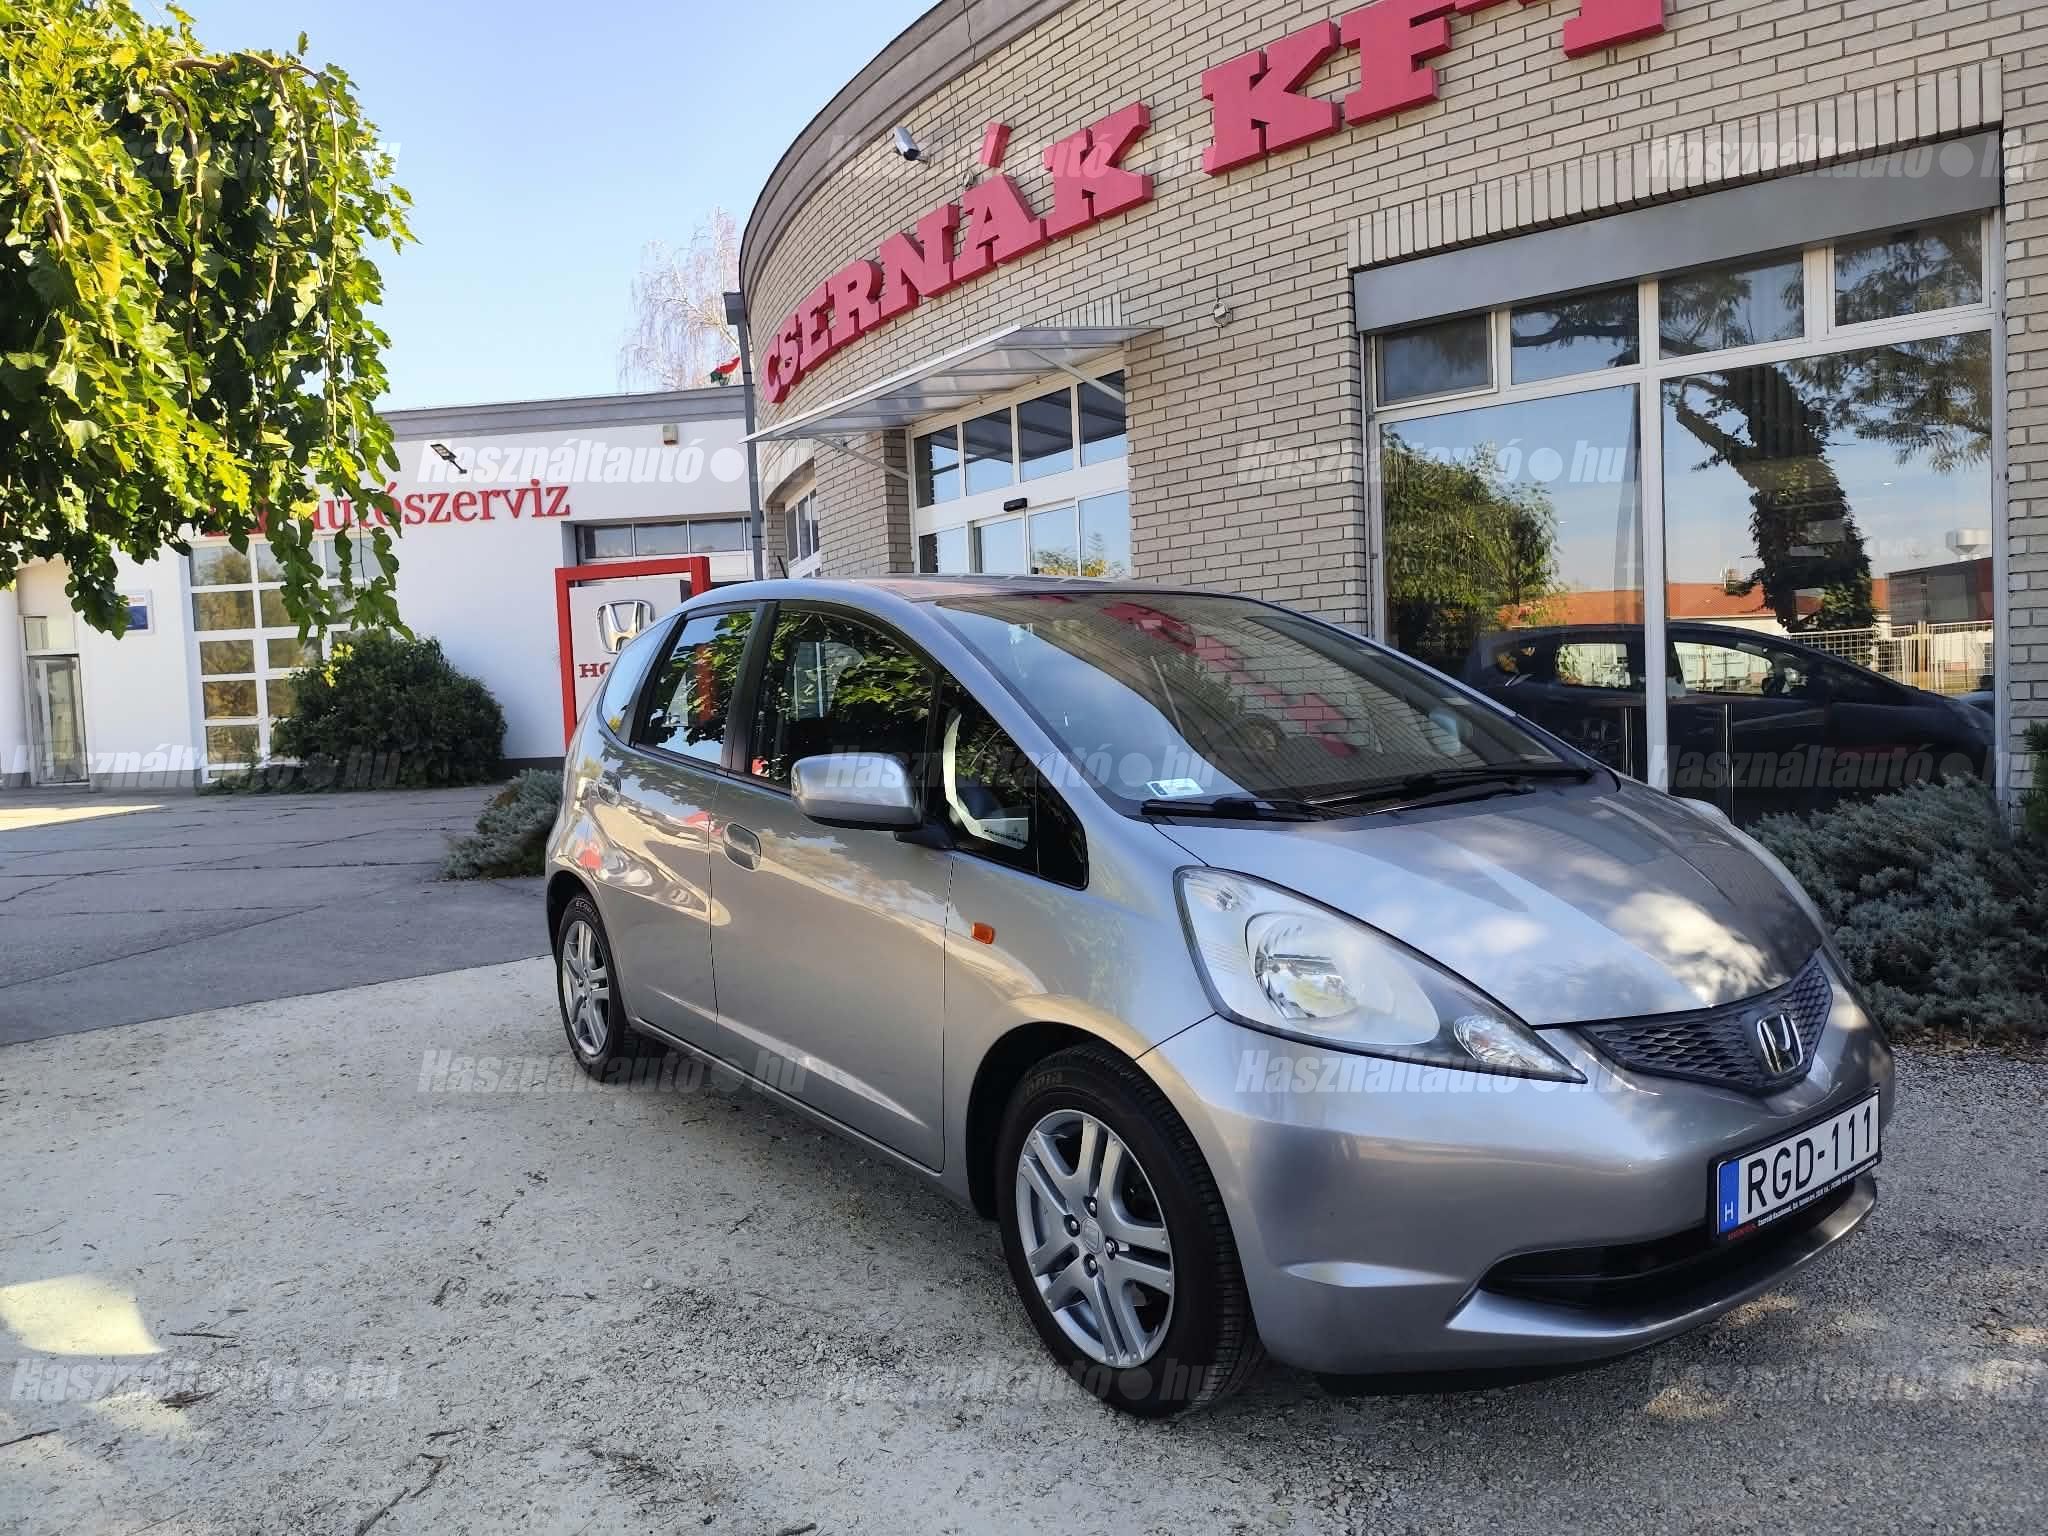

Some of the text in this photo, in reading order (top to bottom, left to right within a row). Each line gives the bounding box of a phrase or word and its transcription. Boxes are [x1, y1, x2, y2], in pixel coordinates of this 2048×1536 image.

[762, 101, 1153, 403] CSERNÁK
[1724, 1201, 1734, 1222] H
[1748, 1106, 1872, 1215] RGD-111
